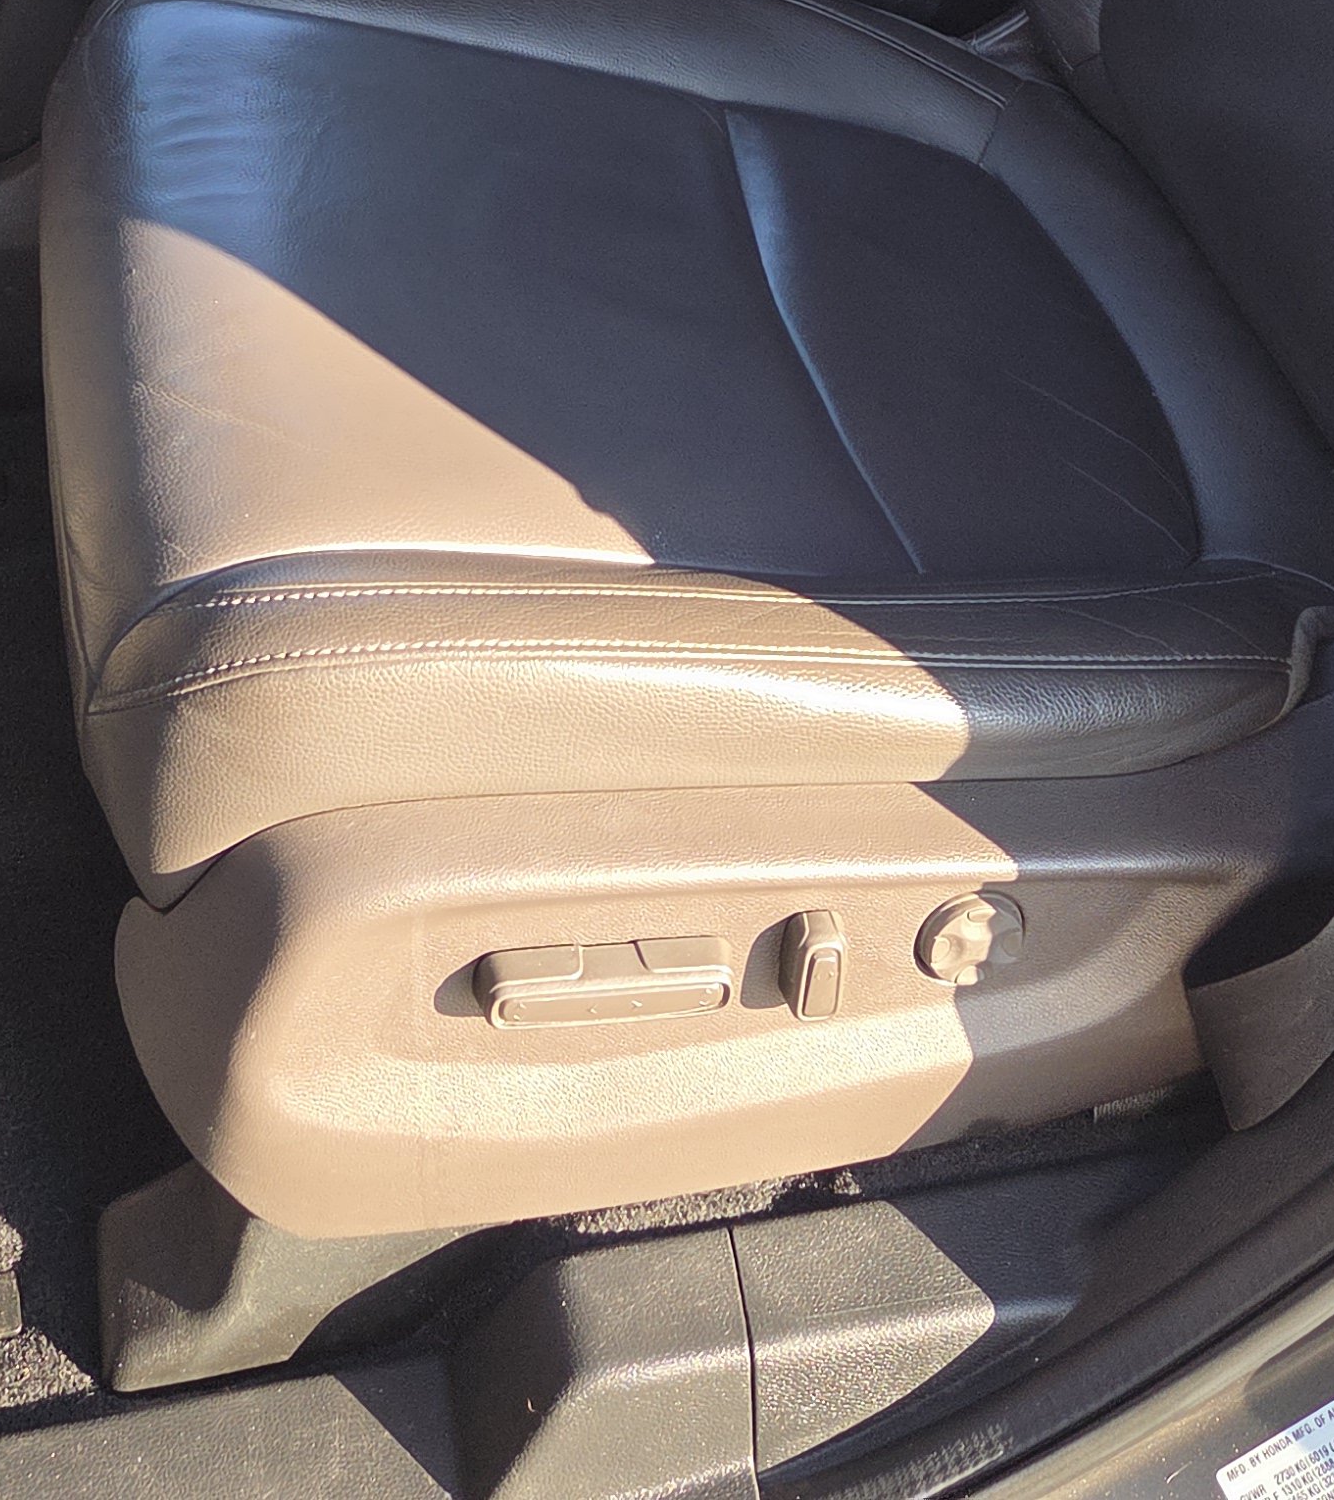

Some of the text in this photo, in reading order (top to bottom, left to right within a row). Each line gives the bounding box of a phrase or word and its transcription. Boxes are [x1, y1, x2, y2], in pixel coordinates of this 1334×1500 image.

[1227, 1463, 1250, 1481] MFD.
[1249, 1452, 1261, 1467] BY
[1262, 1435, 1293, 1459] HONDA
[1314, 1413, 1326, 1427] OF
[1281, 1477, 1303, 1496] 1310
